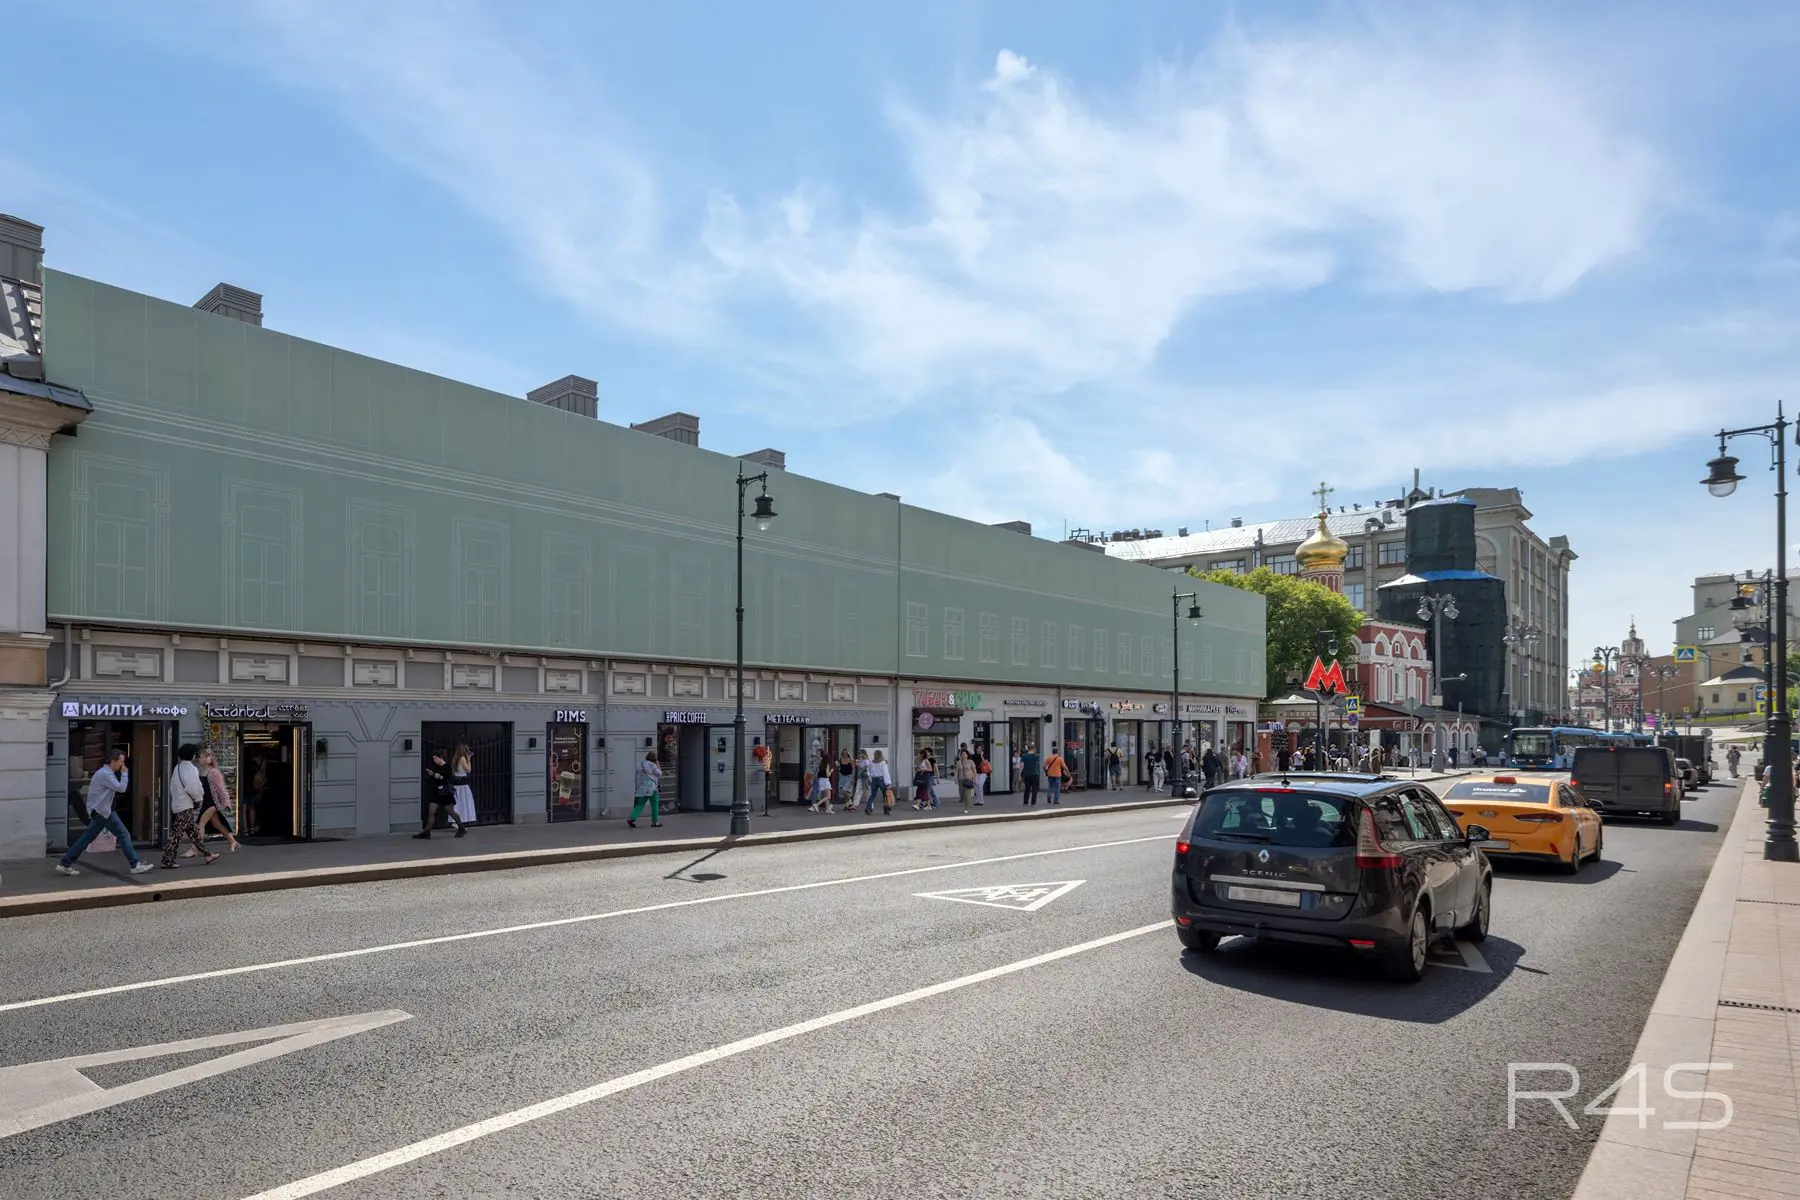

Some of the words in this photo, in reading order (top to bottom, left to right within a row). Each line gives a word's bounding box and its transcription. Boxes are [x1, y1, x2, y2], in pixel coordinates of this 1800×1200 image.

[82, 704, 143, 716] МИЛТИ
[556, 710, 586, 722] PIMS
[670, 712, 687, 723] PRICE
[687, 712, 706, 723] COFFEE
[766, 714, 780, 723] MET
[782, 715, 795, 723] TEA
[1241, 869, 1287, 878] SCENIC
